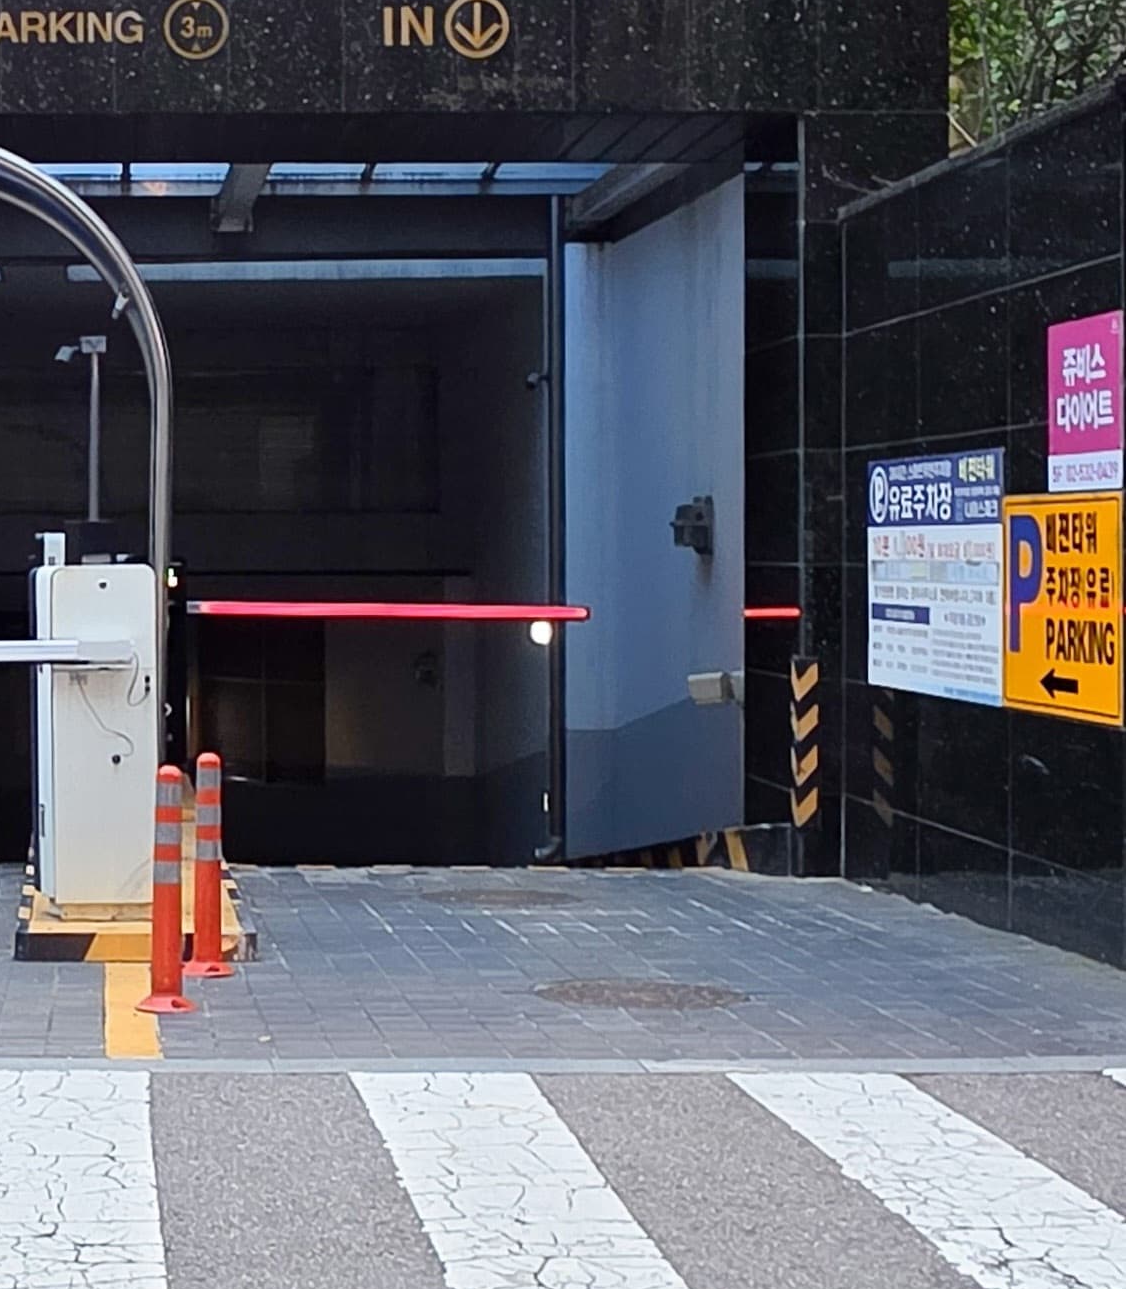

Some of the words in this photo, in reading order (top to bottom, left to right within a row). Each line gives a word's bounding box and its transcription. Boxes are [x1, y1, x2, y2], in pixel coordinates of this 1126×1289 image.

[180, 15, 213, 39] 3m
[383, 5, 434, 47] IN
[1062, 343, 1107, 387] 쥬비스
[1056, 389, 1115, 433] 다이어트
[888, 482, 952, 521] 유료주차장
[1045, 511, 1098, 554] 비젼타워
[1009, 514, 1042, 653] P
[1045, 566, 1081, 608] 주차장
[1086, 566, 1111, 608] 유료
[1045, 618, 1115, 666] PARKING
